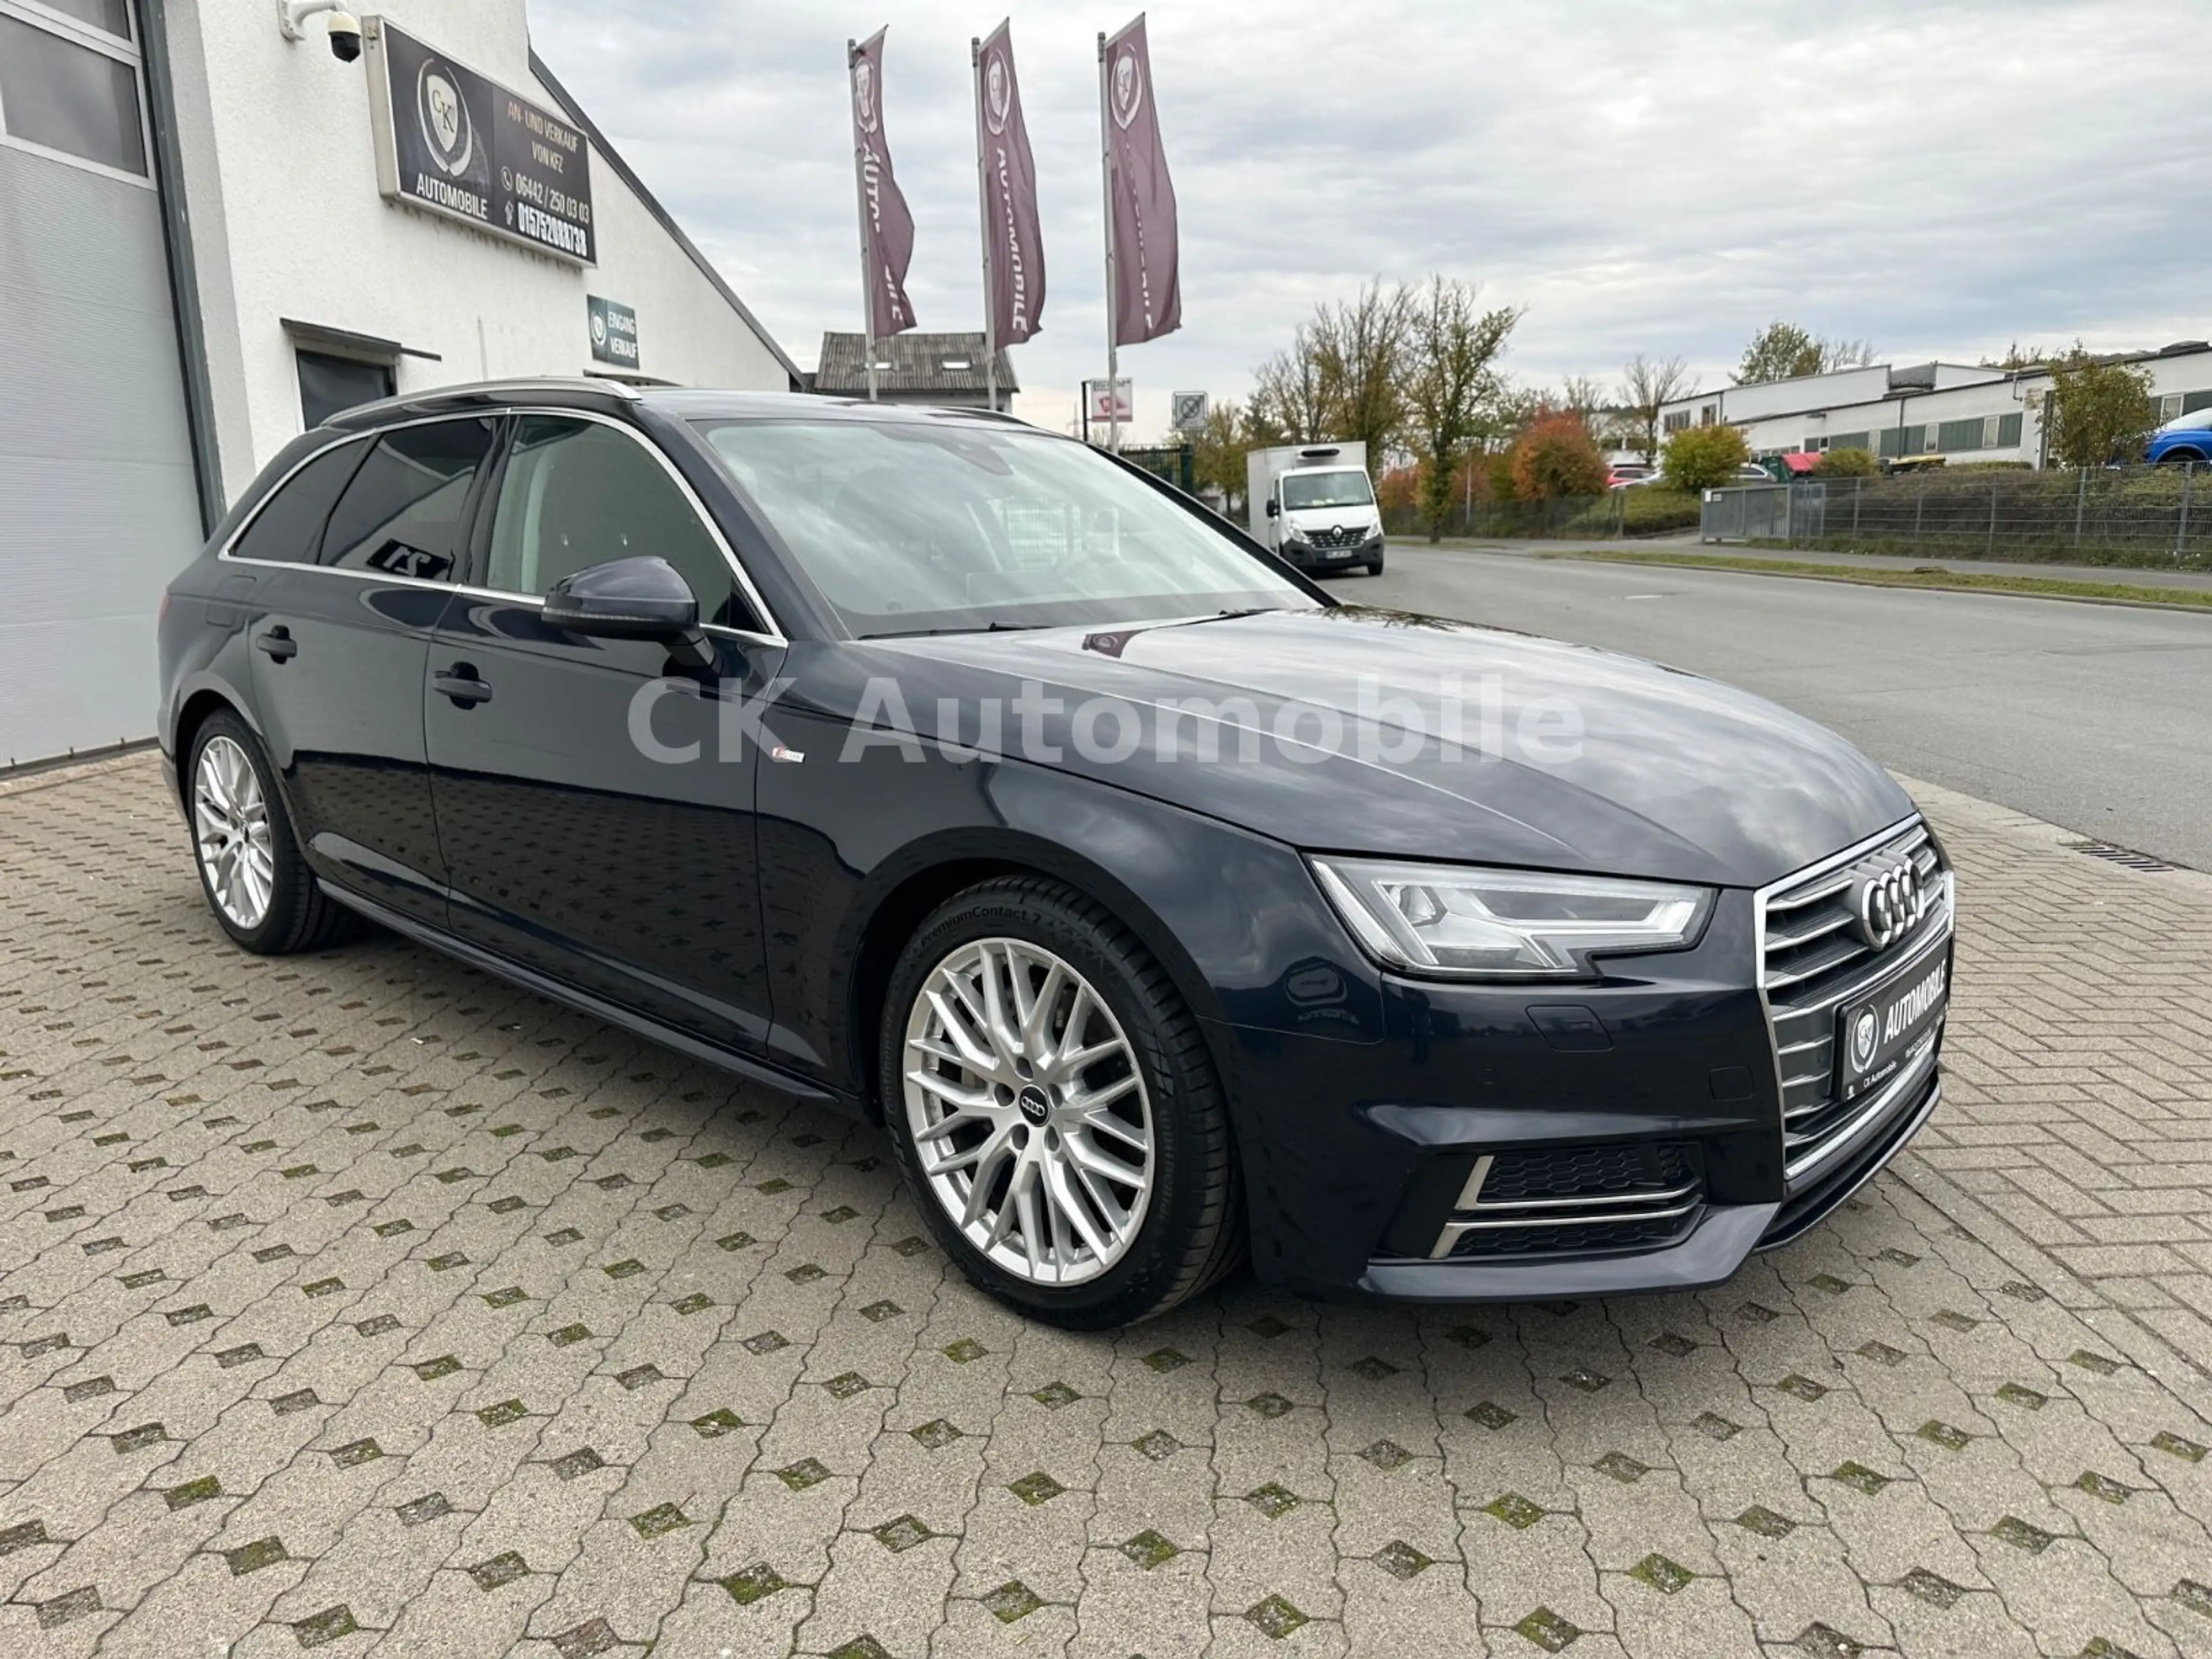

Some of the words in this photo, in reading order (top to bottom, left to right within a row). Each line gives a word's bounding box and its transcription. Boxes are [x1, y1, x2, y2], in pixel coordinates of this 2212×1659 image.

[532, 141, 549, 167] VON
[416, 172, 488, 220] AUTOMOBILE
[515, 172, 543, 204] 06442
[550, 188, 565, 214] 250
[566, 196, 577, 219] 03
[579, 202, 590, 224] 03
[1883, 958, 1946, 1045] AUTOMOBILE
